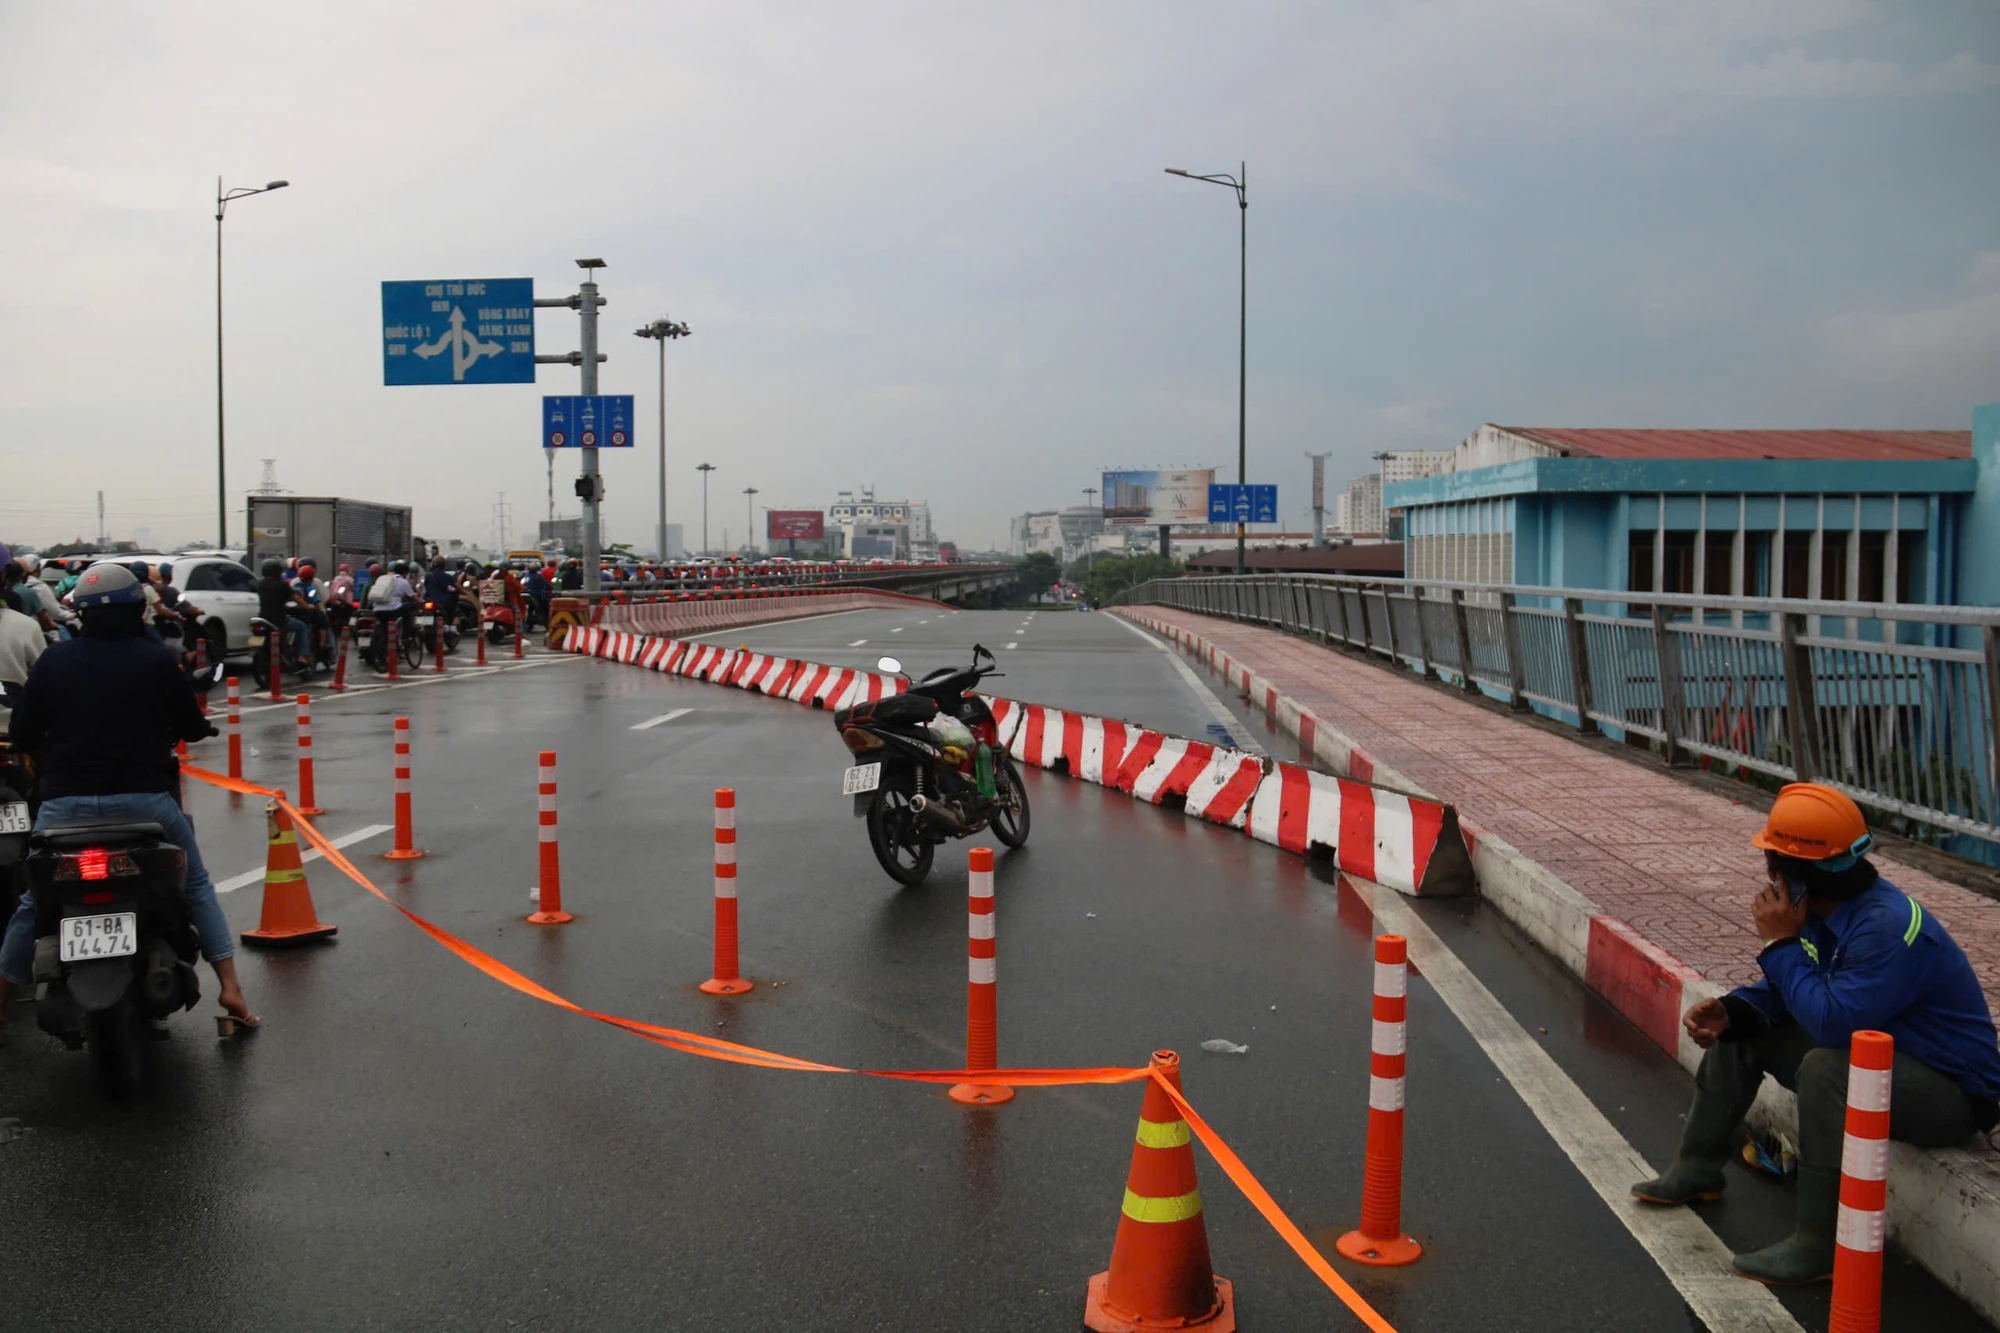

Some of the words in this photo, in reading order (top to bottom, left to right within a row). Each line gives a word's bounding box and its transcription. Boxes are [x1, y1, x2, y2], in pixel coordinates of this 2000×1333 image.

[505, 308, 531, 320] XOAY
[506, 324, 532, 336] XANH
[73, 917, 123, 938] 61-BA
[68, 935, 131, 958] 144.74
